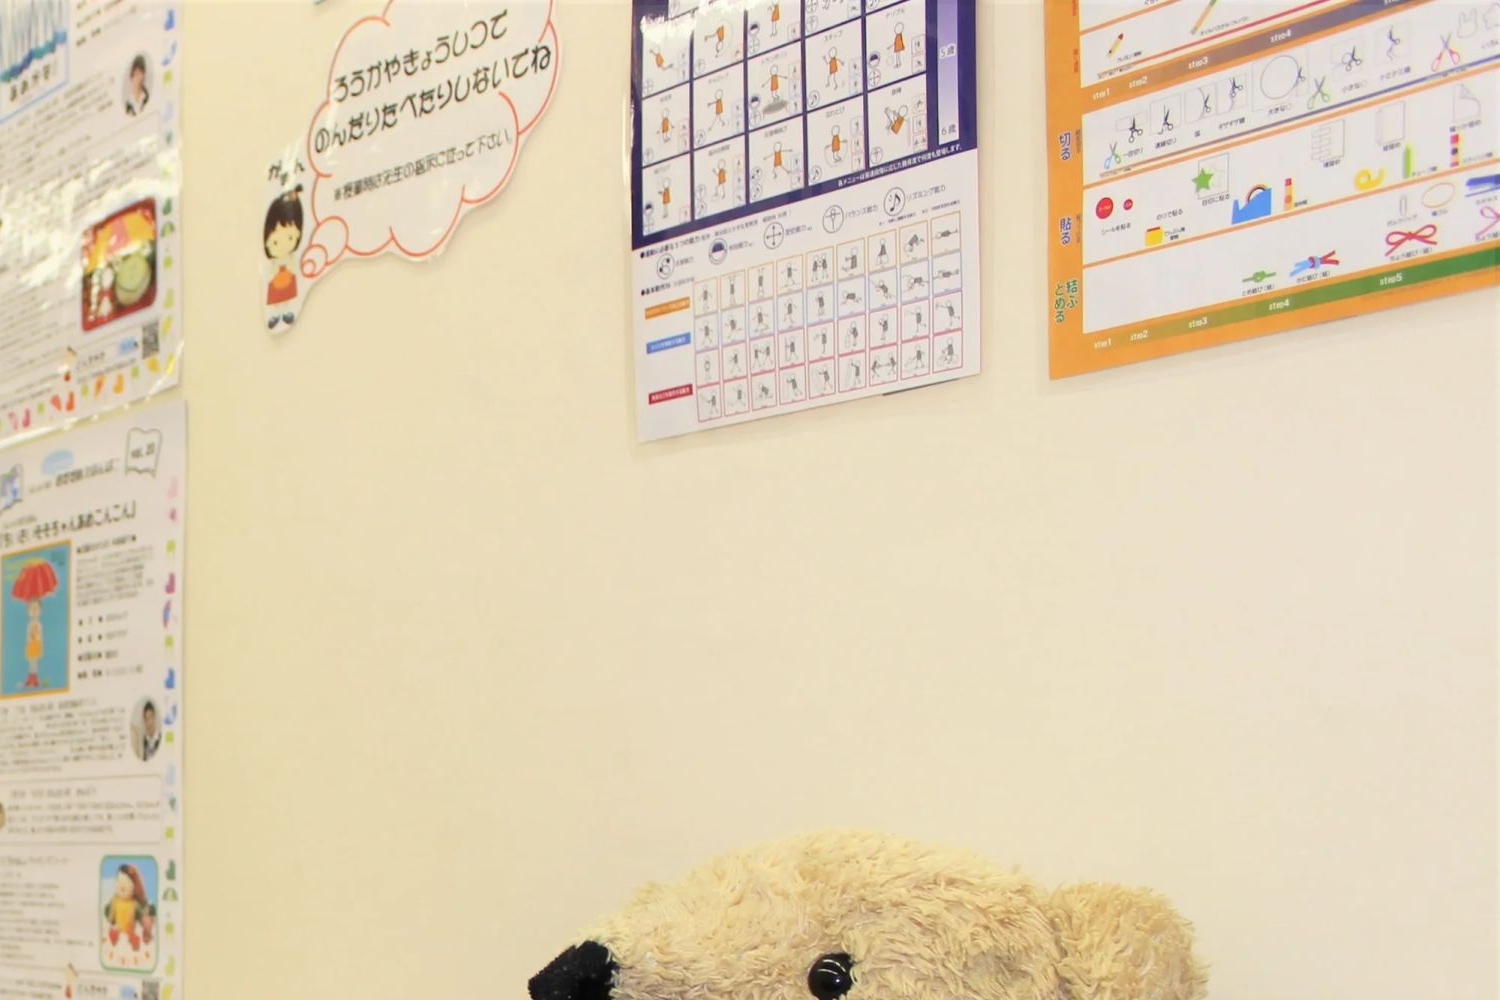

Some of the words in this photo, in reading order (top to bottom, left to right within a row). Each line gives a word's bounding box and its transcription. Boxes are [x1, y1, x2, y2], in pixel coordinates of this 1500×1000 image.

[1188, 57, 1208, 69] step3
[1129, 75, 1148, 88] step2
[1093, 88, 1110, 100] step1
[1060, 132, 1071, 160] 切る
[1060, 217, 1071, 244] 貼る
[1380, 274, 1403, 286] step5
[1055, 284, 1065, 323] とめる
[1269, 298, 1289, 310] step4
[1188, 317, 1207, 328] step3
[1130, 330, 1148, 341] step2
[1094, 338, 1111, 349] step1
